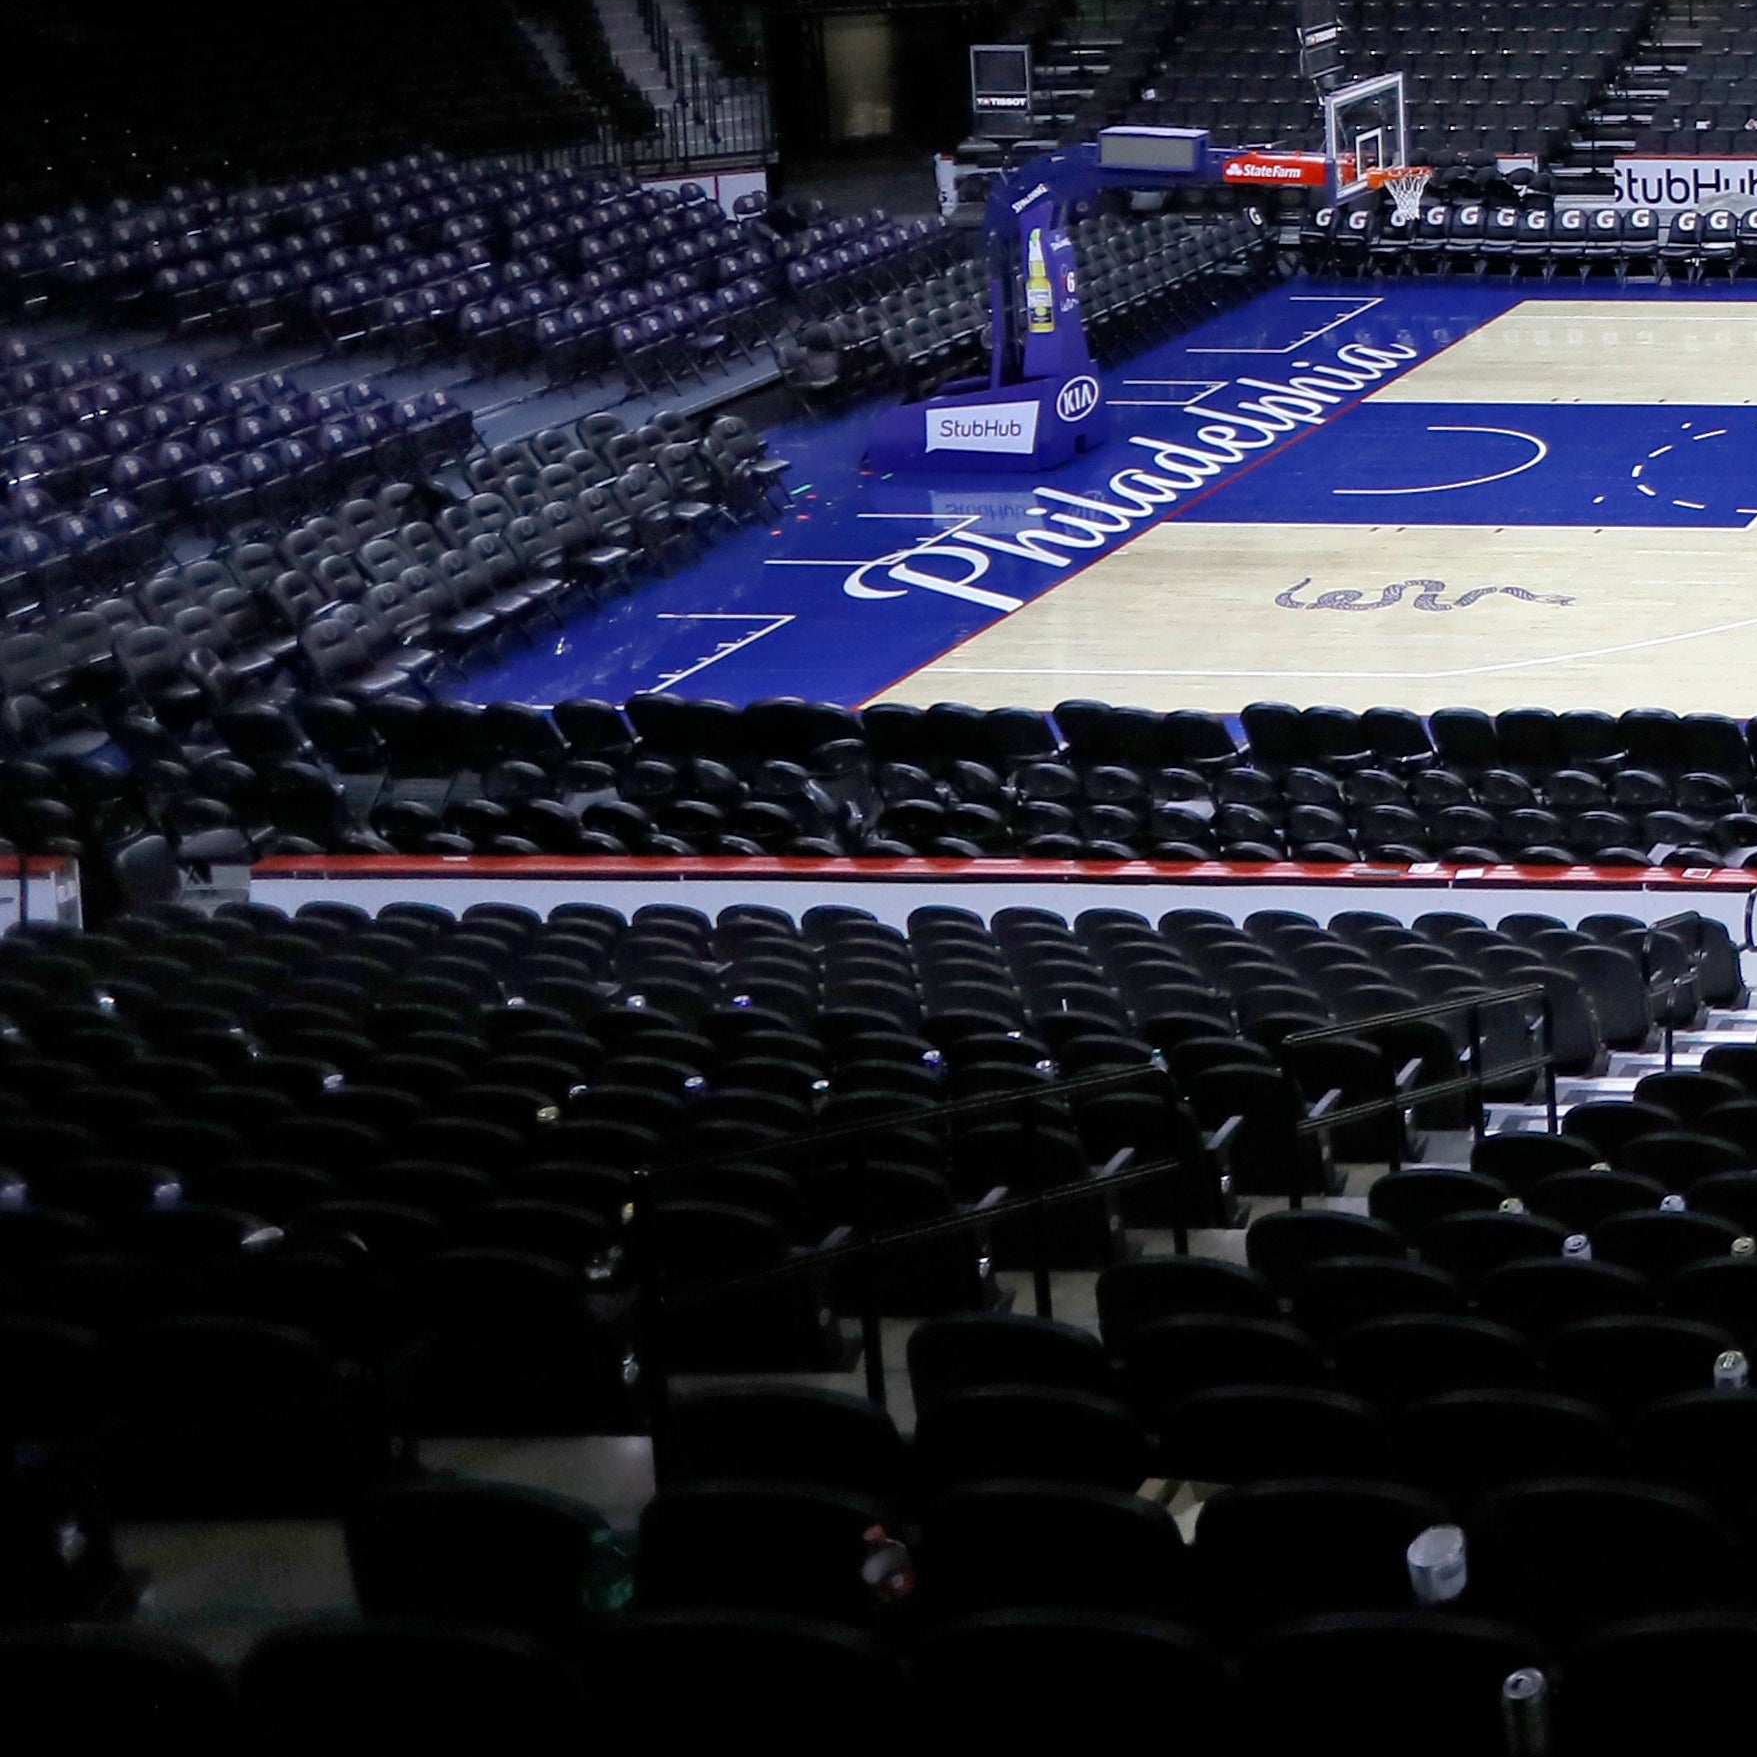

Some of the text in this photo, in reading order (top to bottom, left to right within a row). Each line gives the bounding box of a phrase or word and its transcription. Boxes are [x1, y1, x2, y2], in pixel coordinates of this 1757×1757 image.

[1316, 208, 1334, 226] G
[1349, 210, 1368, 229] G
[1427, 207, 1446, 225] G
[1461, 207, 1479, 225] G
[1497, 208, 1516, 227] G
[1528, 210, 1547, 229] G
[1562, 210, 1580, 228] G
[1596, 210, 1615, 228] G
[1632, 209, 1650, 227] G
[1678, 212, 1697, 231] G
[1710, 210, 1728, 229] G
[1062, 381, 1094, 416] KIA
[940, 419, 1021, 437] StubHub
[844, 342, 1417, 613] Philadelphia
